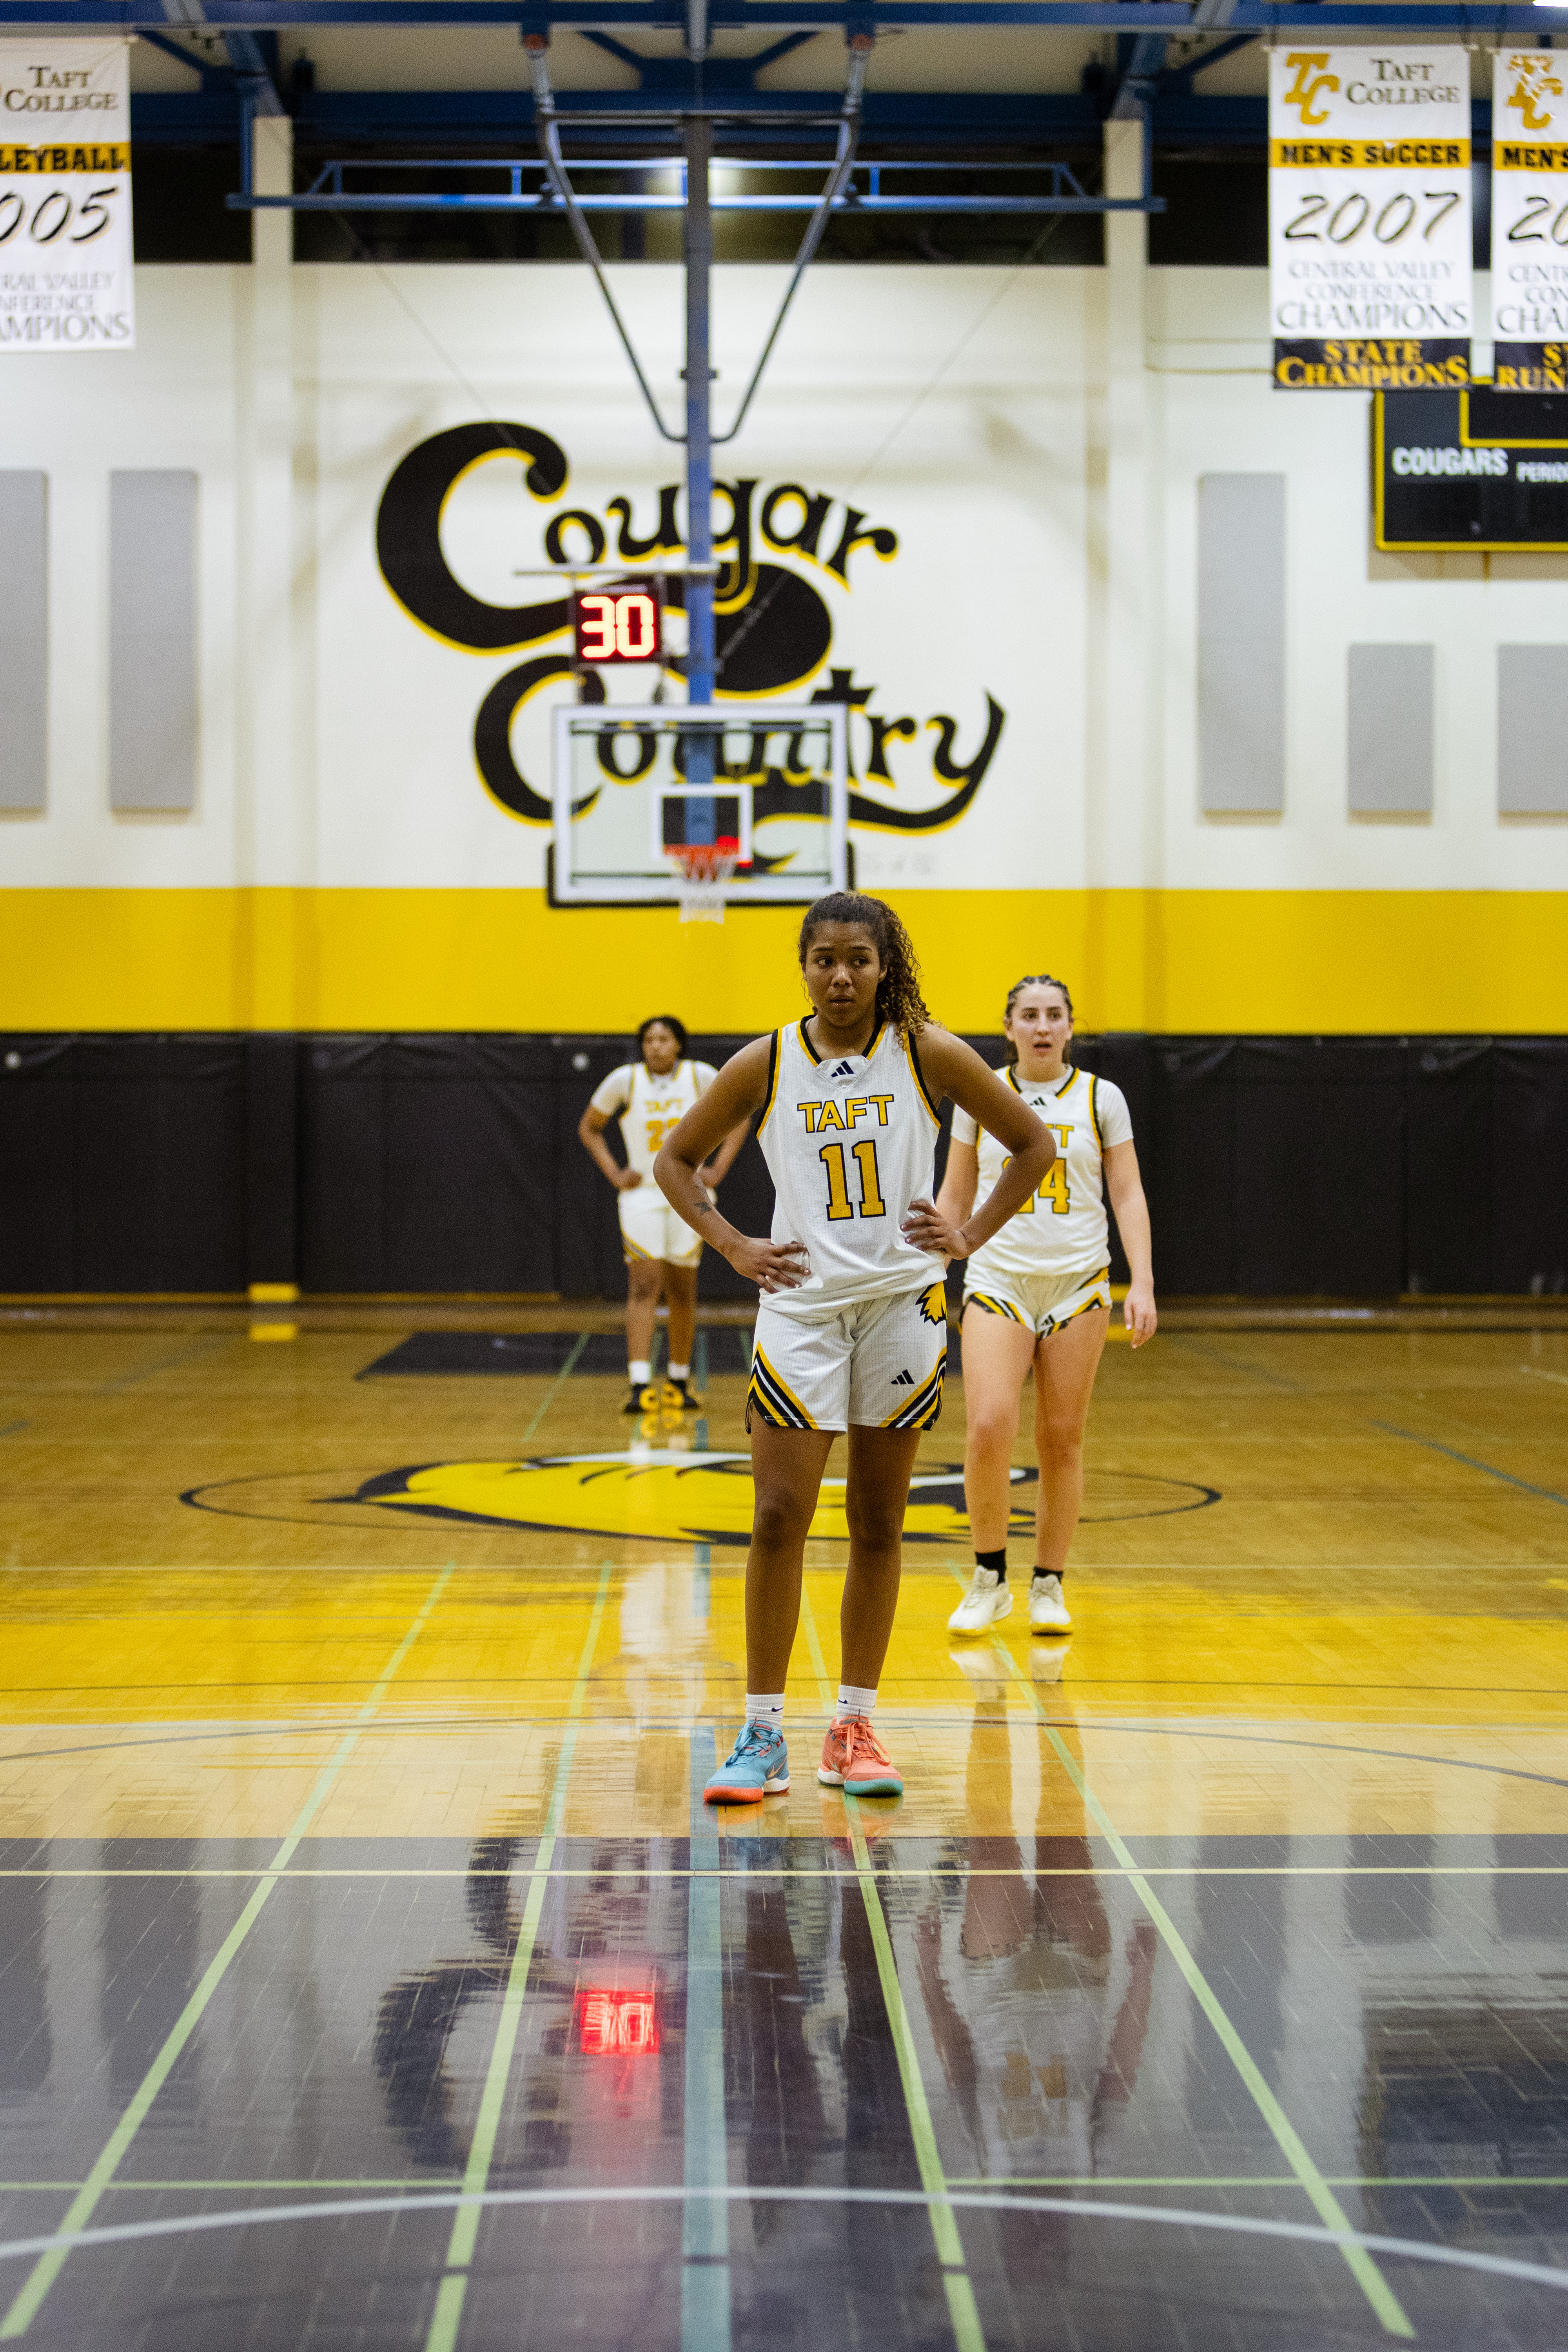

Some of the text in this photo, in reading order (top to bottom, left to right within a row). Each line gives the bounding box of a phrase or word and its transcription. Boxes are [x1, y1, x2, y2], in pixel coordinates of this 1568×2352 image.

[28, 65, 94, 88] TAFT
[1369, 58, 1435, 81] TAFT
[4, 89, 119, 112] COLLEGE
[1345, 81, 1461, 105] COLLEGE
[1281, 145, 1461, 165] MEN'S SOCCER
[1285, 192, 1463, 247] 2007
[43, 270, 115, 291] VALLEY
[1288, 259, 1455, 279] CENTRAL VALLEY
[1305, 282, 1438, 301] CONFERENCE
[1276, 300, 1468, 330] CHAMPIONS
[1323, 339, 1424, 363] STATE
[1276, 354, 1469, 387] CHAMPIONS
[1392, 447, 1509, 476] COUGARS
[375, 420, 900, 698] Cougar
[581, 595, 655, 659] 30
[797, 1094, 895, 1134] TAFT
[818, 1139, 886, 1221] 11
